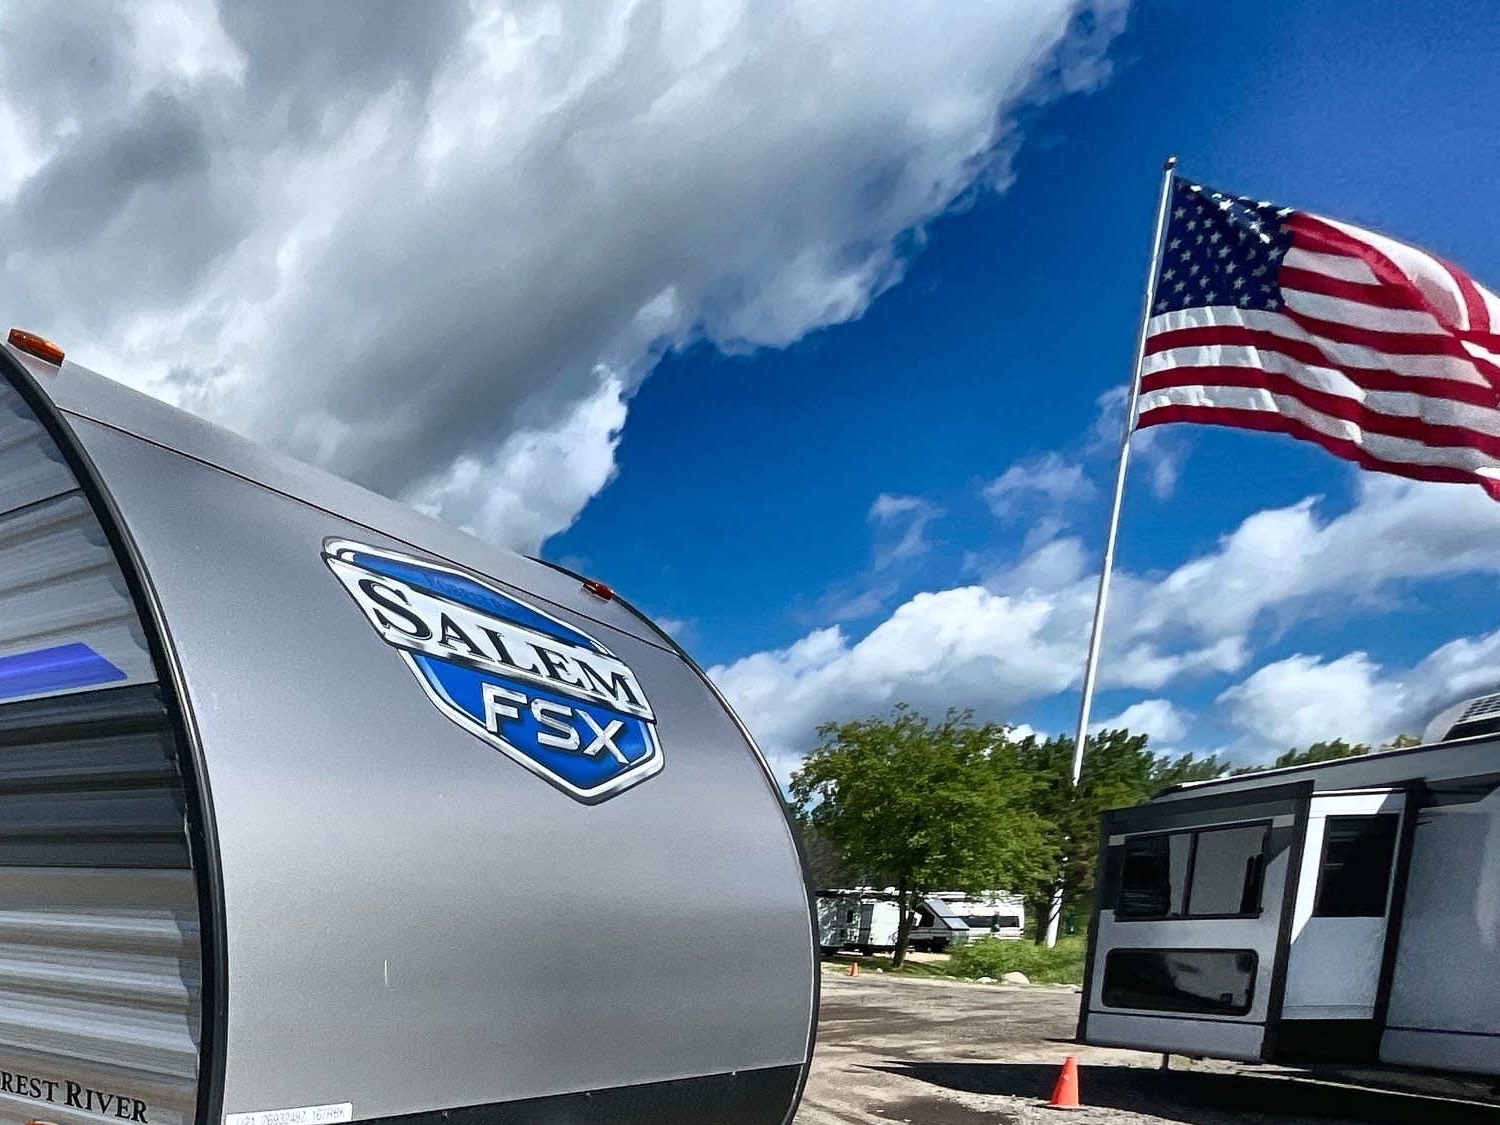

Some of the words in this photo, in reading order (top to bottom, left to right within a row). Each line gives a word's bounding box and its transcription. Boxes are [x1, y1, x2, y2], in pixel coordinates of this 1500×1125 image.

[357, 578, 646, 710] SALEM
[481, 682, 631, 765] FSX
[63, 1079, 149, 1124] RIVER
